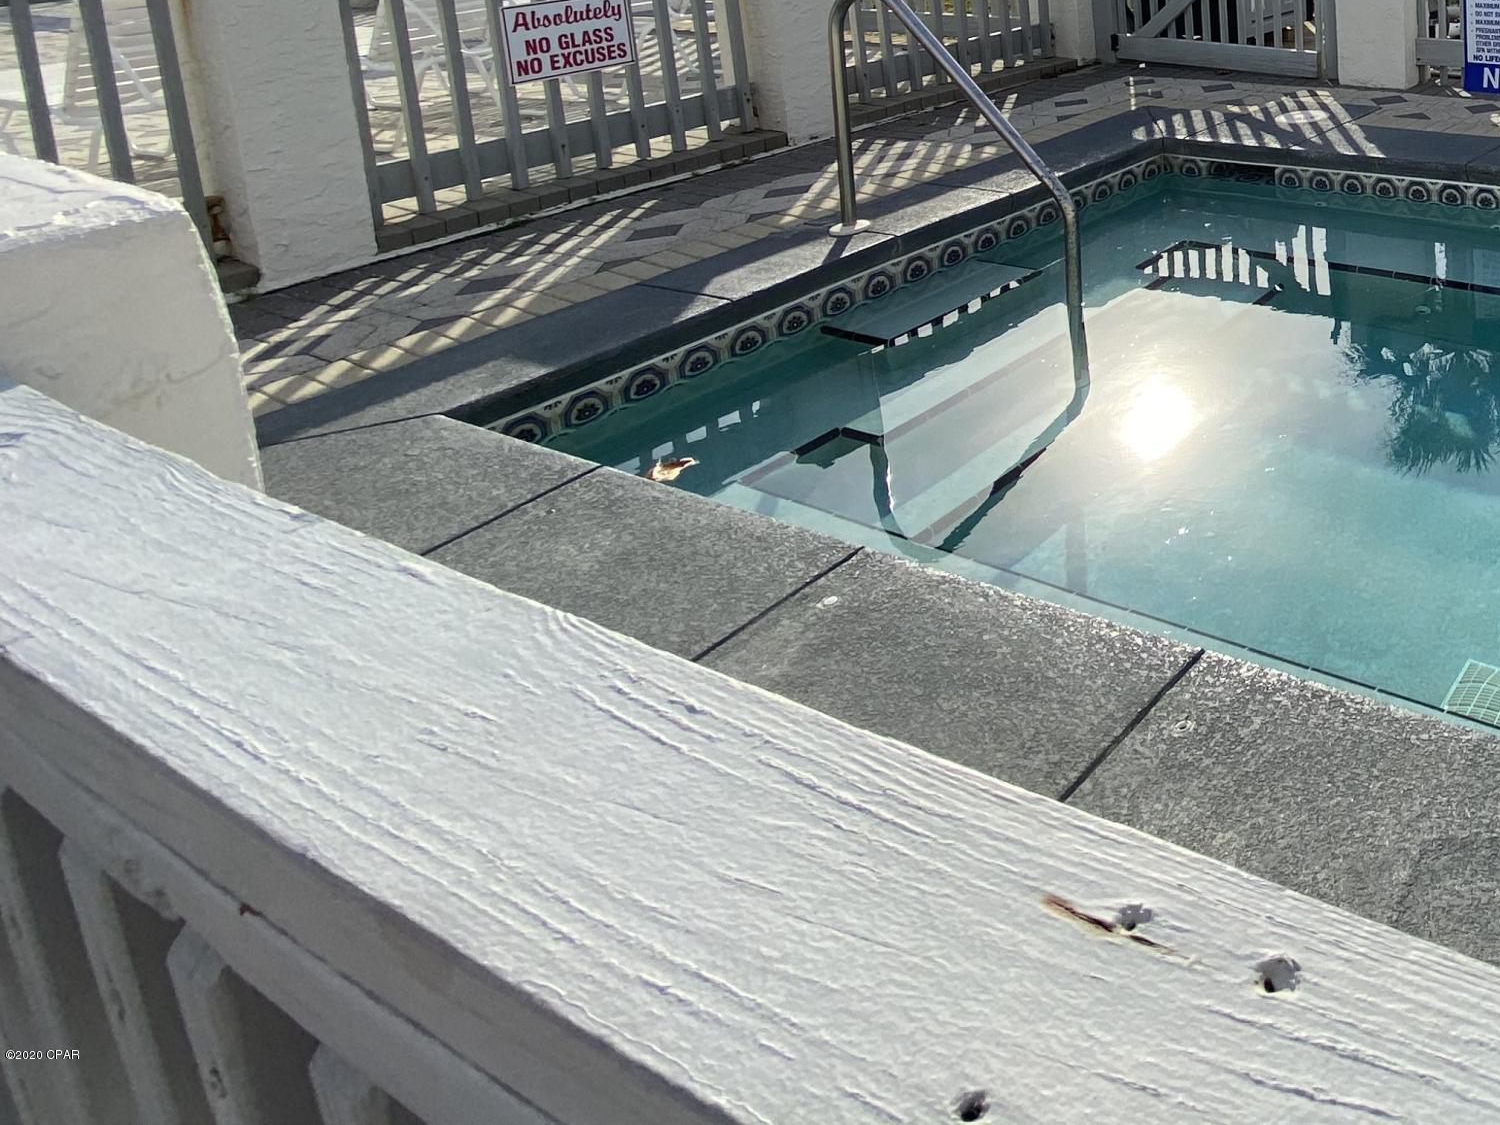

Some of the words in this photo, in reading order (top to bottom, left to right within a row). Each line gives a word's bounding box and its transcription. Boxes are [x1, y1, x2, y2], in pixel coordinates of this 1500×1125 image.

[512, 0, 622, 33] Absolutely
[524, 37, 550, 56] NO
[558, 26, 614, 50] GLASS
[516, 58, 543, 76] NO
[550, 42, 628, 71] EXCUSES
